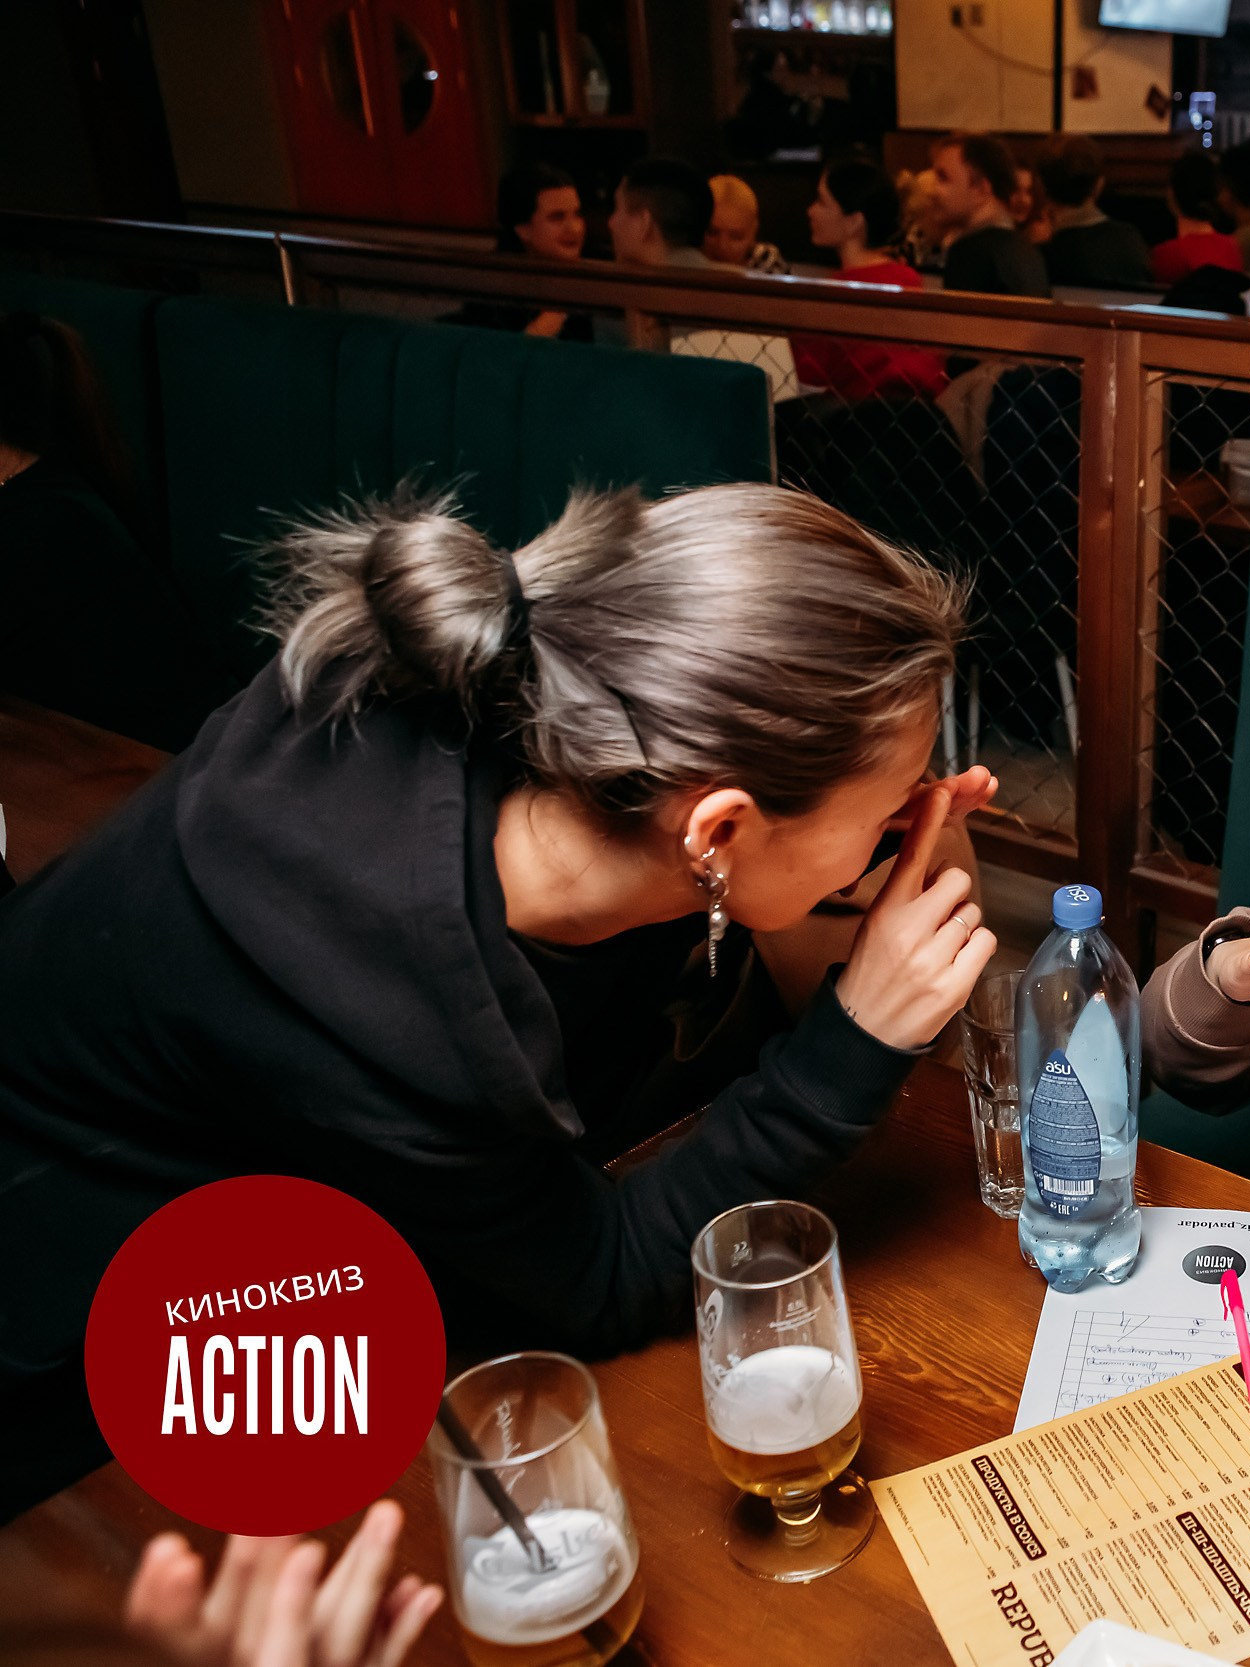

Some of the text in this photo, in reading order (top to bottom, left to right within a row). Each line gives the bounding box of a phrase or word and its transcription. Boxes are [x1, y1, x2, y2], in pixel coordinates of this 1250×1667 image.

[1196, 1255, 1234, 1268] ACTION
[974, 1457, 1018, 1516] ПРОДУКТЫ
[991, 1582, 1055, 1667] REPUB
